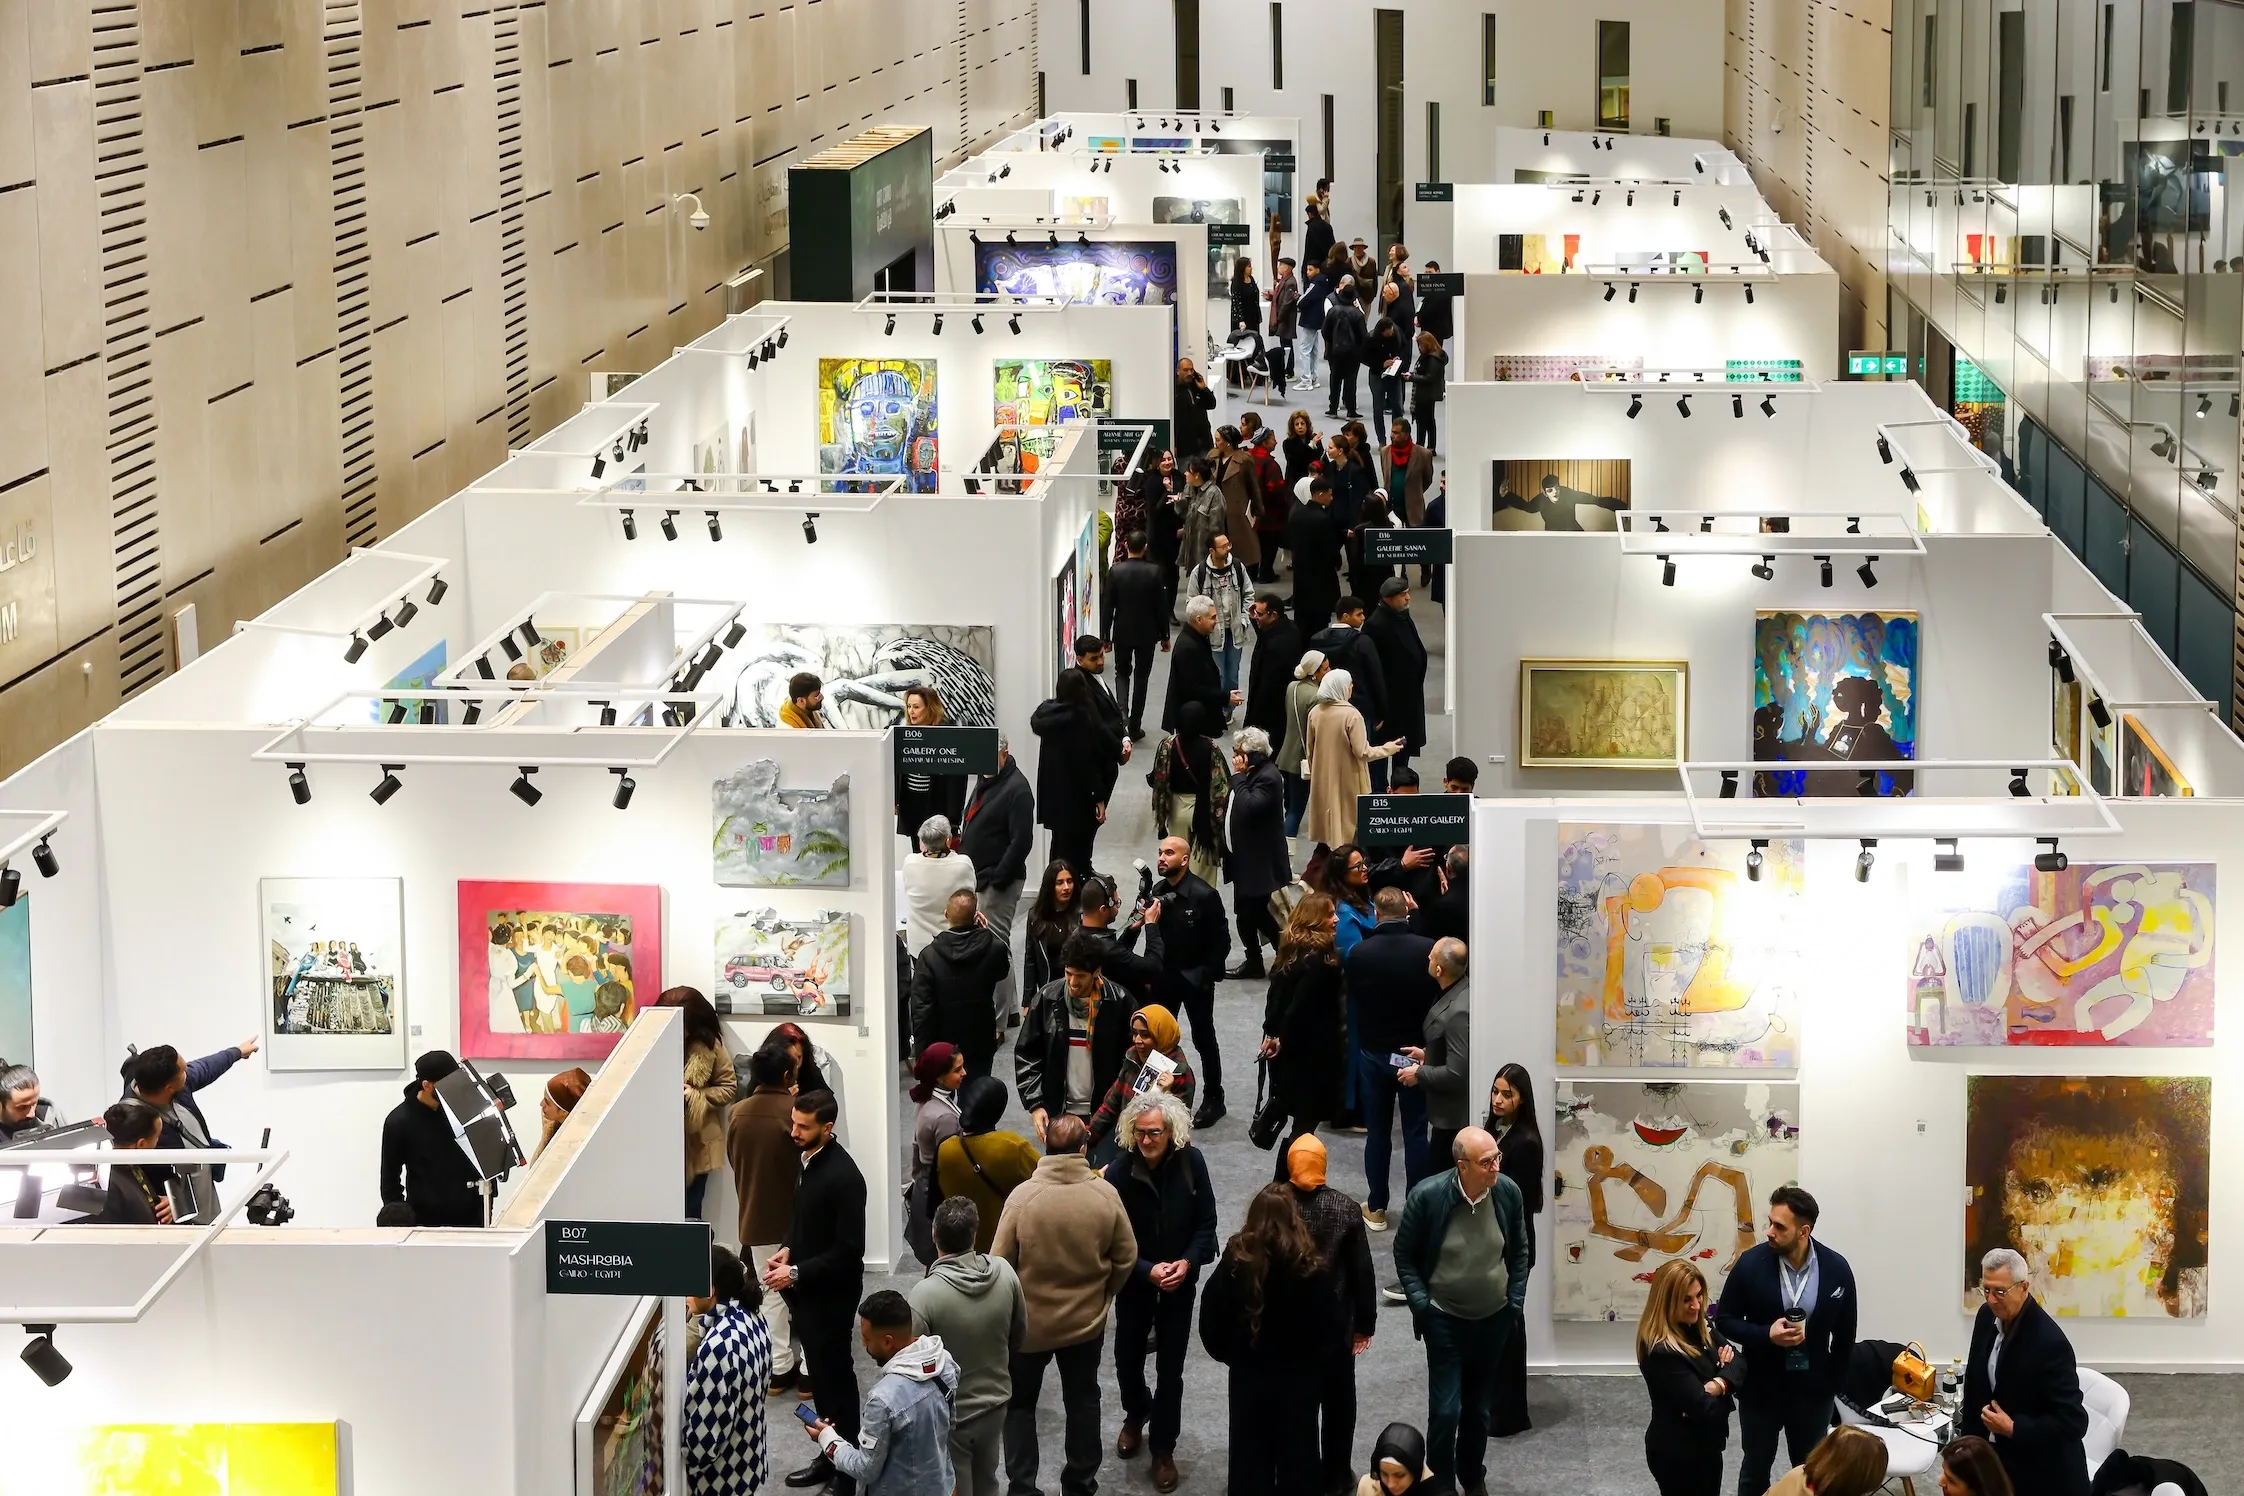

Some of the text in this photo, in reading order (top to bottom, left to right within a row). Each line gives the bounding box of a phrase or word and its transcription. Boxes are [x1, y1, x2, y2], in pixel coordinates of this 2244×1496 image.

[1404, 544, 1427, 552] SANAA
[904, 729, 923, 738] B06
[902, 747, 958, 756] GALLERY ONE
[1372, 799, 1389, 807] B15
[1411, 816, 1428, 825] ART
[1429, 815, 1466, 825] GALLERY
[562, 1227, 587, 1239] B07
[558, 1269, 588, 1278] CAIRO
[594, 1270, 622, 1279] EGYPT
